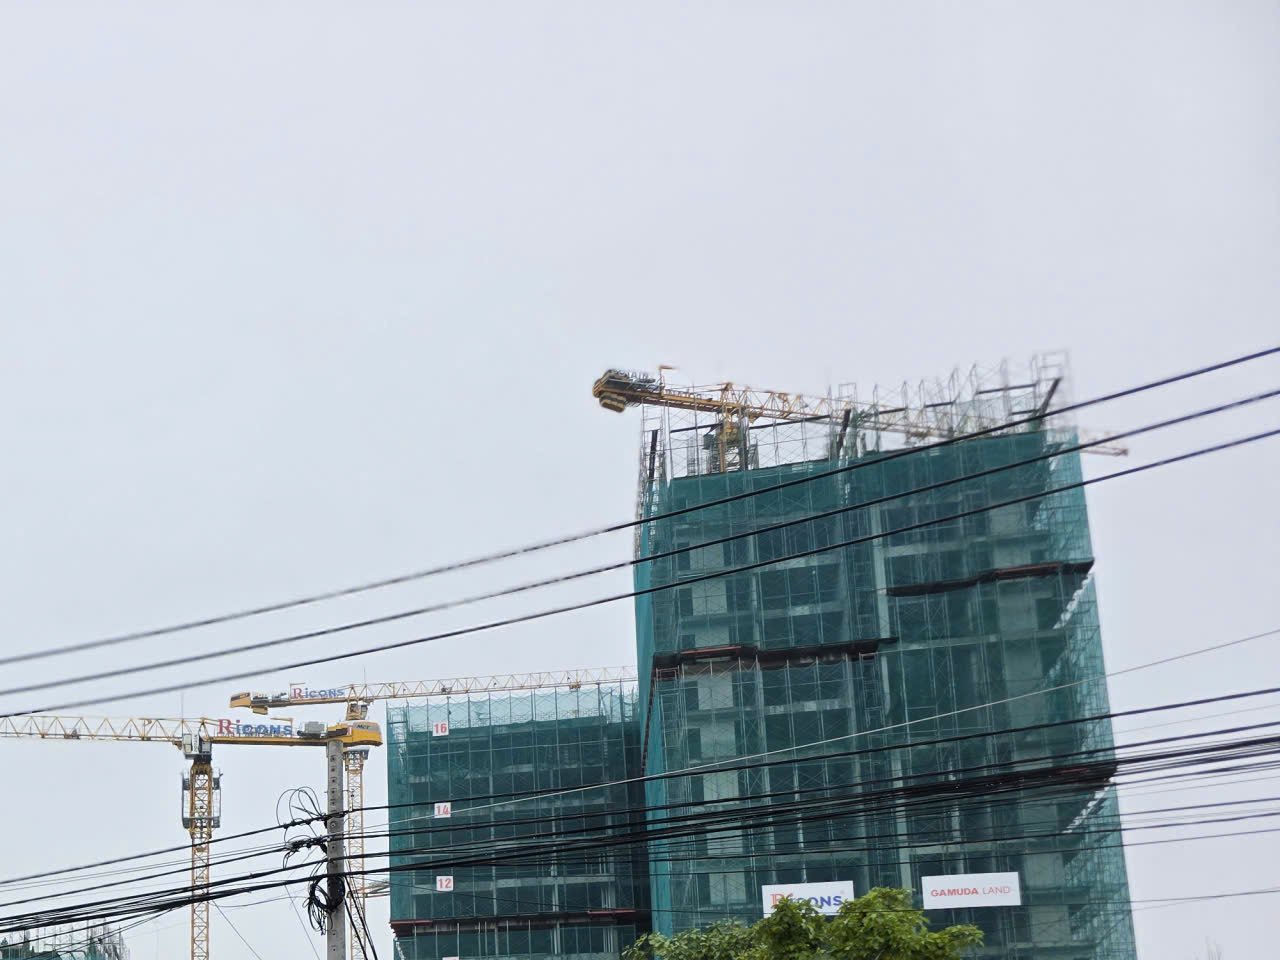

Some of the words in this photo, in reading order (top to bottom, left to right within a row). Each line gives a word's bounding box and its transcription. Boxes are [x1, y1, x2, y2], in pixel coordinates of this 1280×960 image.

[434, 723, 447, 733] 16
[436, 805, 449, 816] 14
[438, 878, 451, 889] 12
[930, 887, 978, 897] GAMUDA
[982, 886, 1010, 895] LAND
